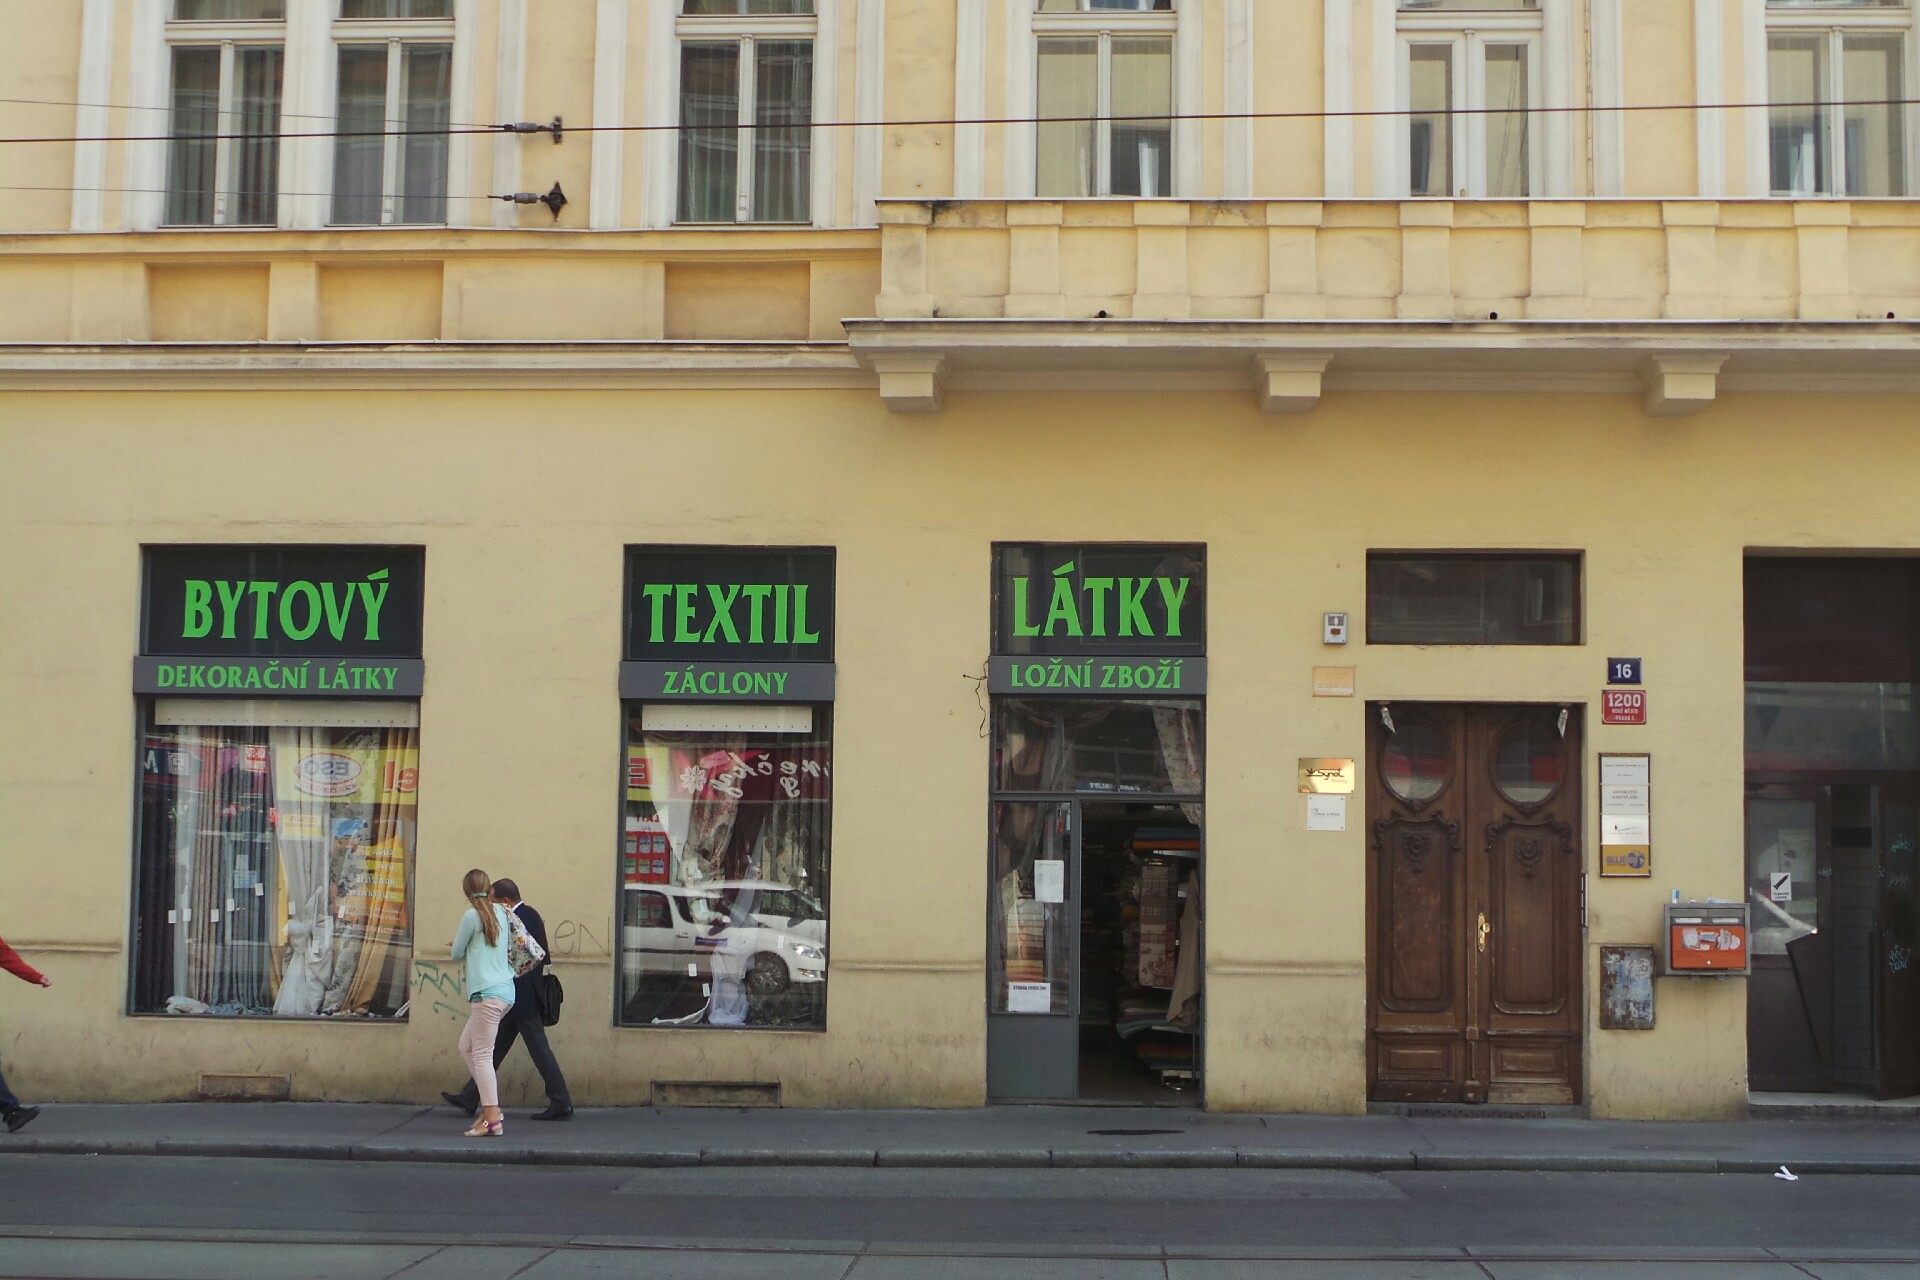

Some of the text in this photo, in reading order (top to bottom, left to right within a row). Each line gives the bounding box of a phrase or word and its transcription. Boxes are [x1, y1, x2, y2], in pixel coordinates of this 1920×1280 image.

[182, 568, 390, 641] BYTOVÝ
[1013, 560, 1191, 637] LÁTKY
[642, 583, 820, 645] TEXTIL
[157, 660, 399, 690] DEKORAČNÍ LÁTKY
[663, 665, 789, 695] ZÁCLONY
[1011, 658, 1184, 689] LOŽNÍ ZBOŽÍ
[1615, 663, 1632, 679] 16
[1608, 693, 1641, 708] 1200
